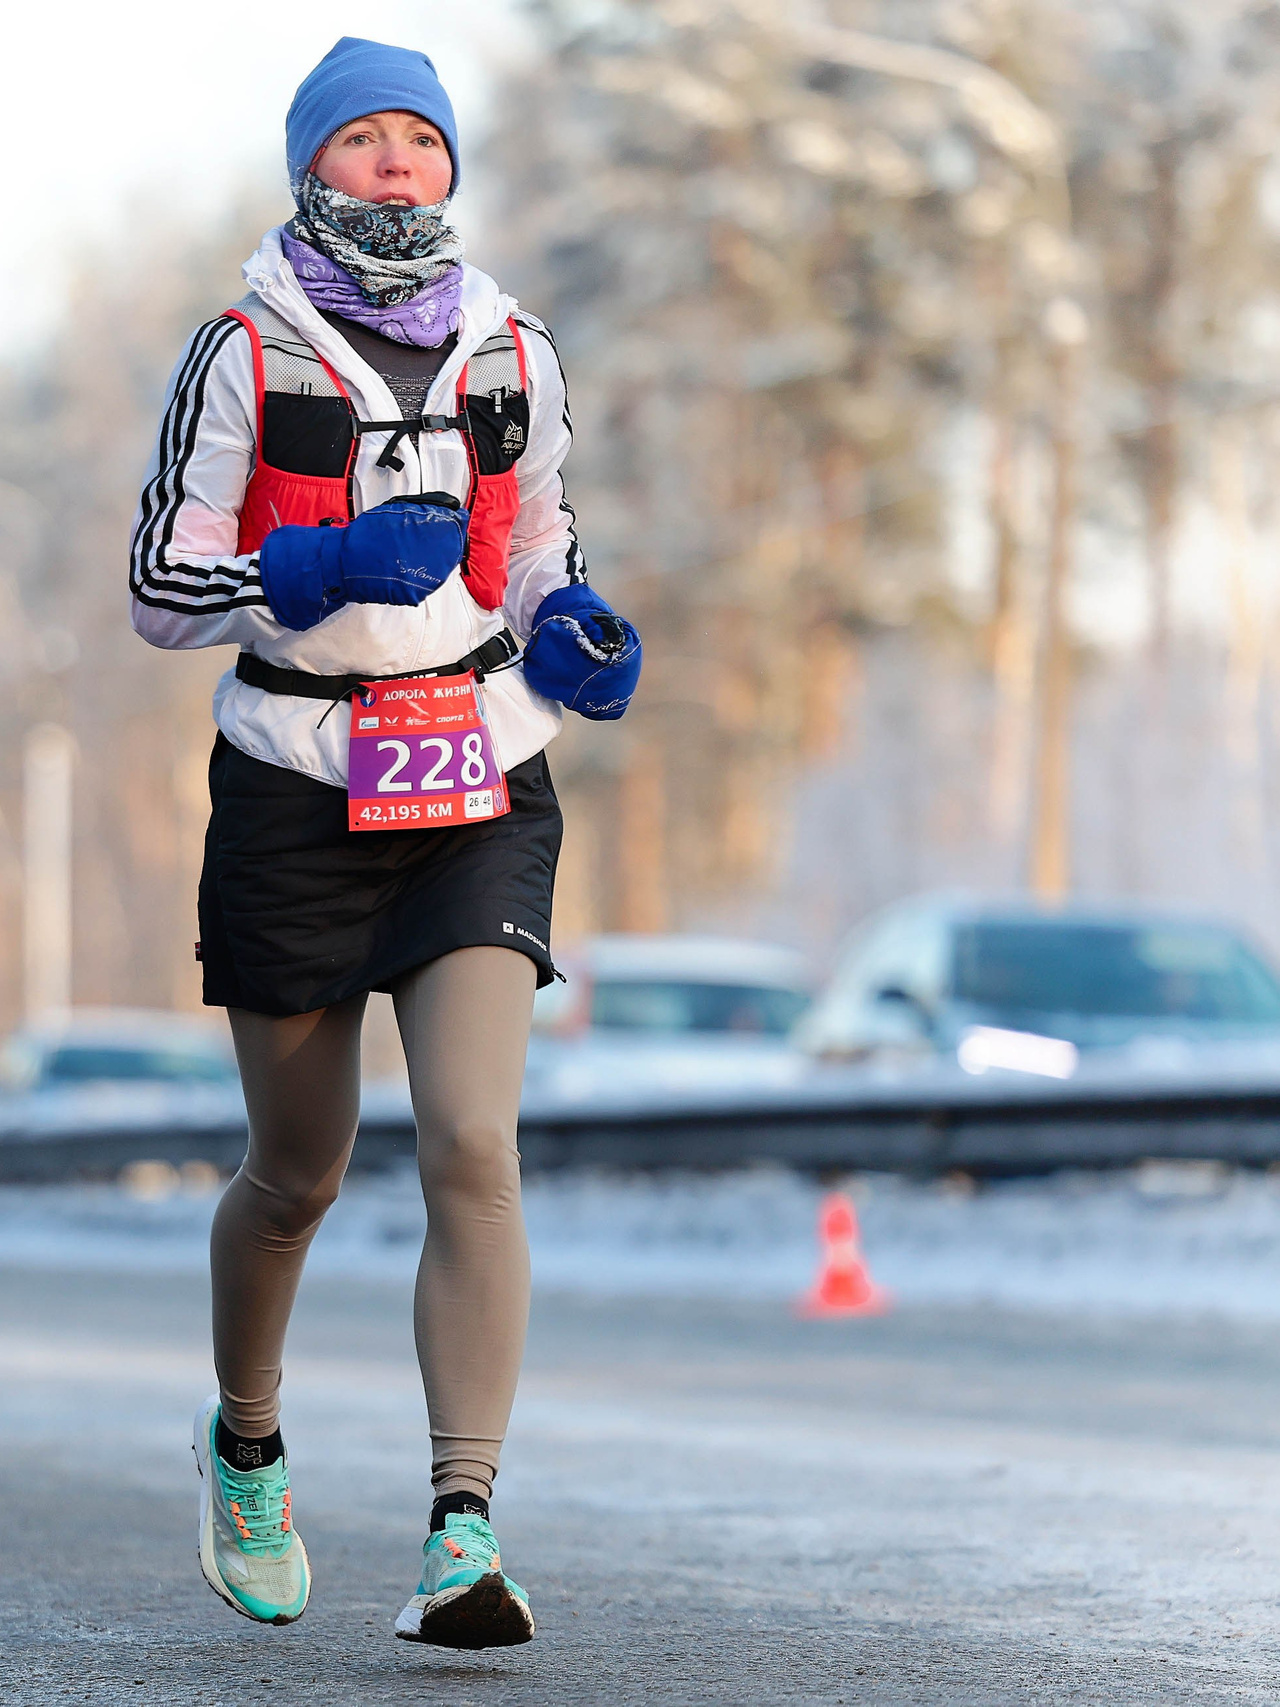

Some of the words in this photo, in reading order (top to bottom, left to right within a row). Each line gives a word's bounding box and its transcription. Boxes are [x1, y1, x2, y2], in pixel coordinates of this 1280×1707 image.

[382, 689, 427, 702] ДОРОГА
[433, 686, 472, 699] ЖИЗНИ
[377, 732, 487, 793] 228
[469, 797, 479, 807] 26
[360, 805, 420, 823] 42,195
[427, 803, 453, 818] КМ
